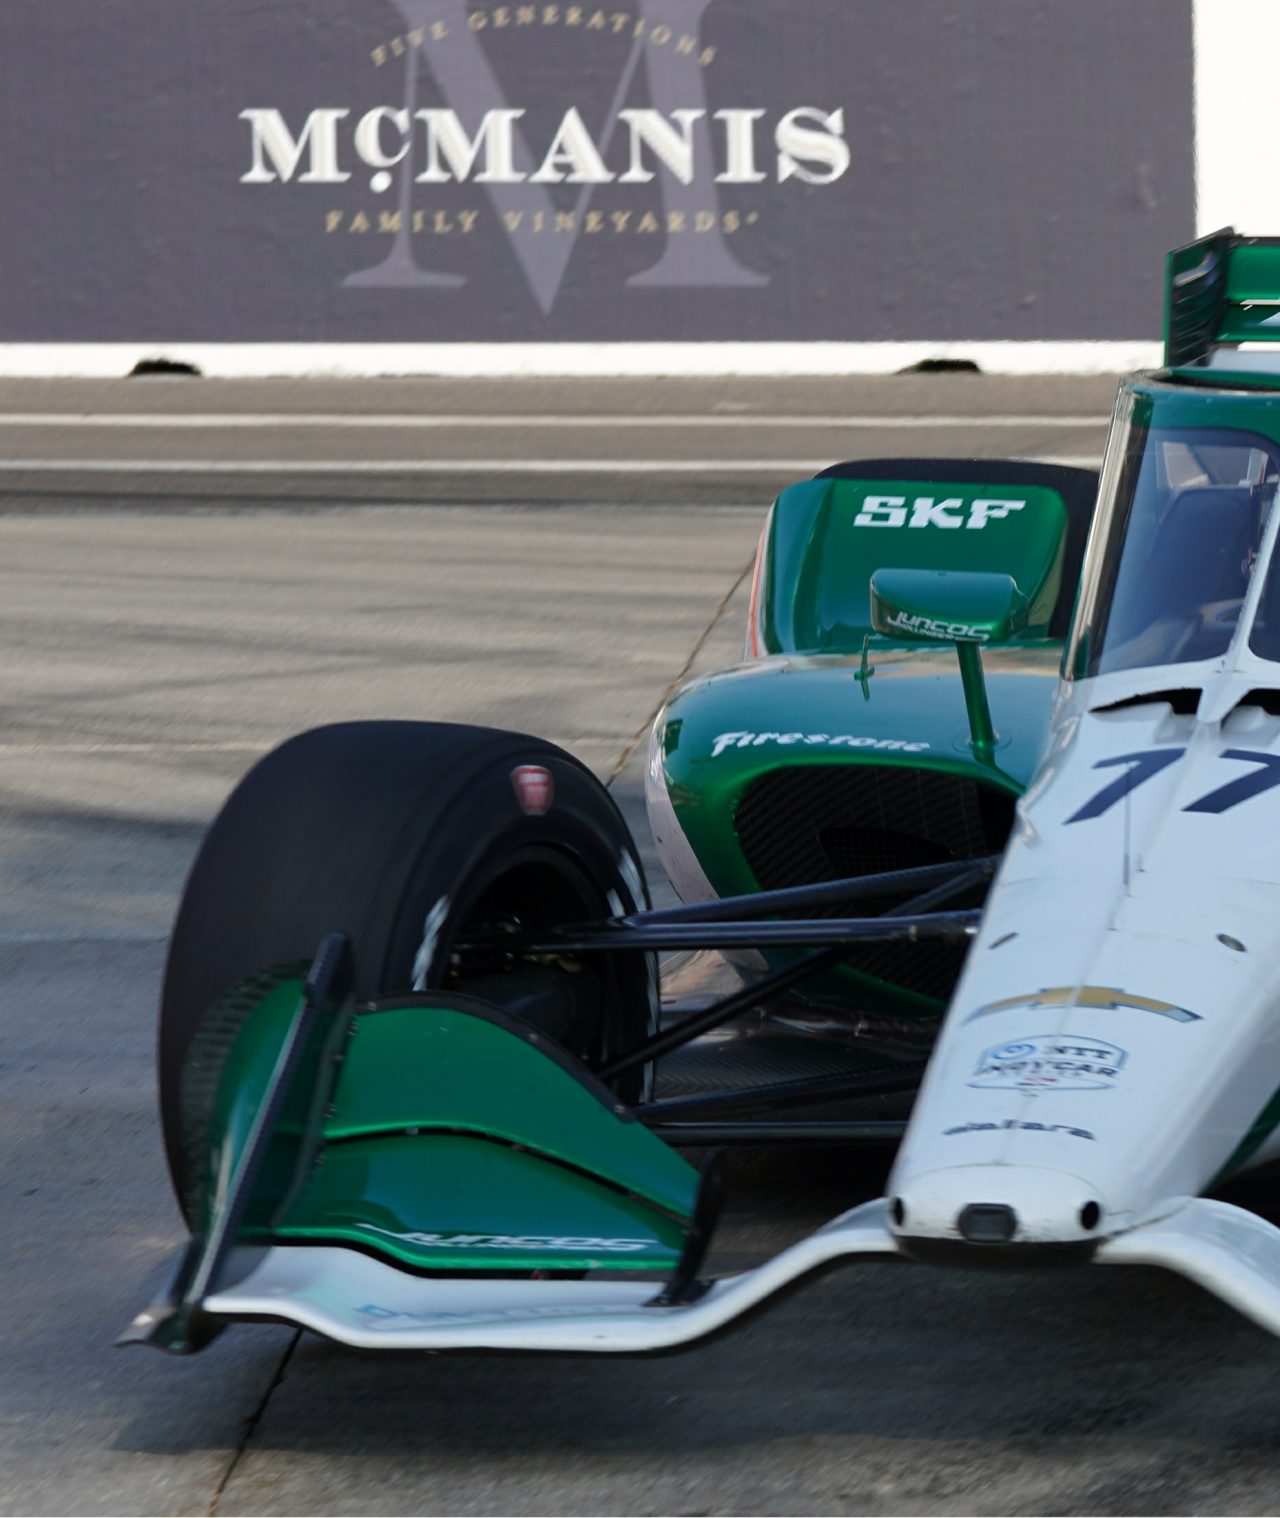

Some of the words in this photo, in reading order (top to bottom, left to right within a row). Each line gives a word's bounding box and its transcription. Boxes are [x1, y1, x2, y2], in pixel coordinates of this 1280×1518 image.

[467, 5, 718, 66] GENERATIONS
[324, 210, 480, 234] FAMILY
[852, 495, 1026, 530] SKF
[710, 730, 931, 758] Firestone
[1046, 1045, 1113, 1060] NTT
